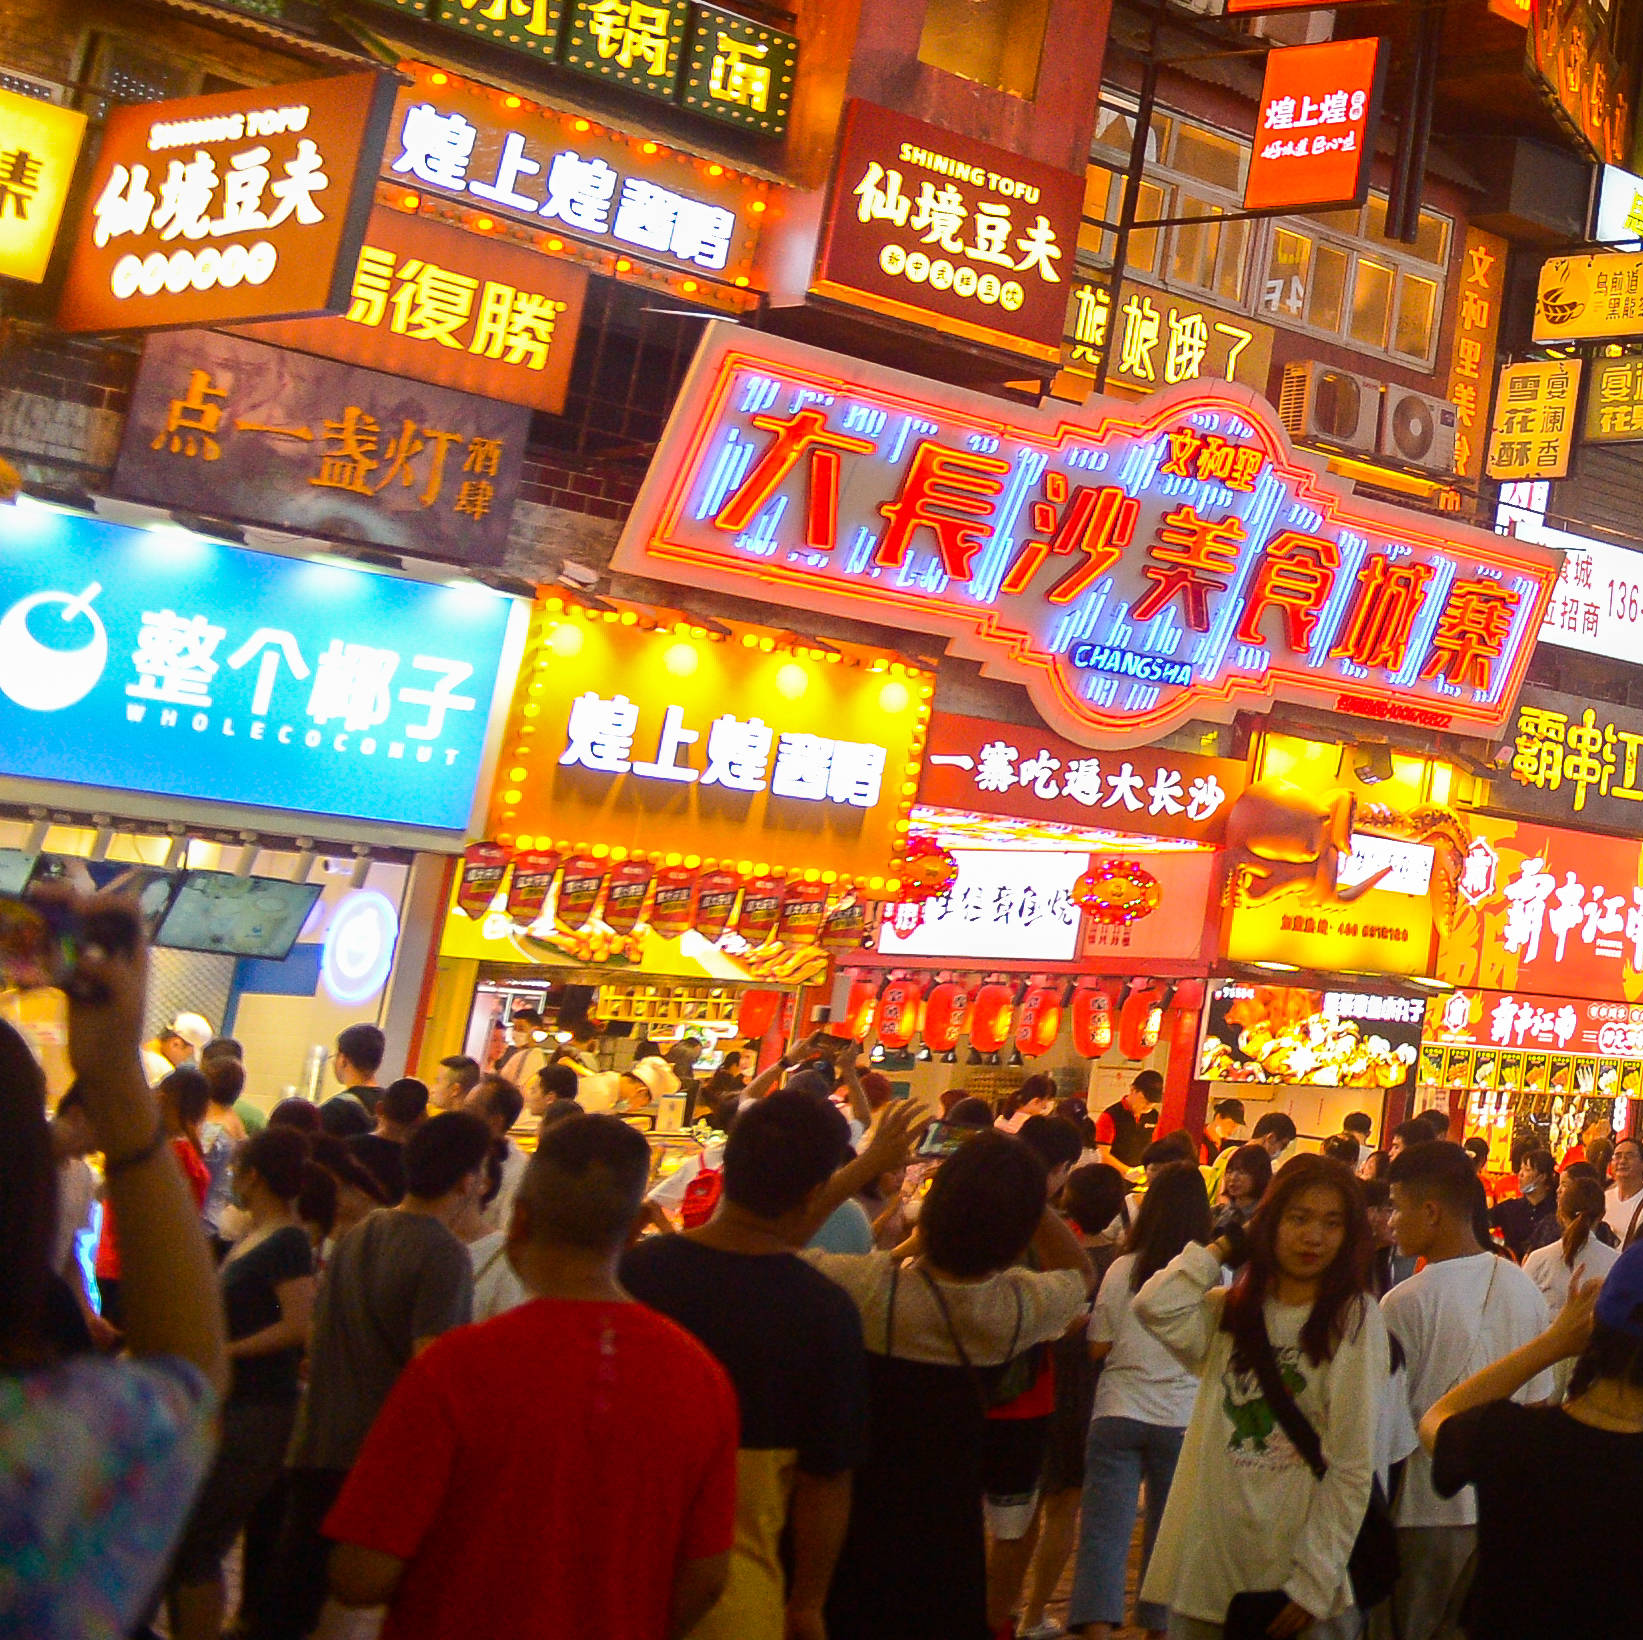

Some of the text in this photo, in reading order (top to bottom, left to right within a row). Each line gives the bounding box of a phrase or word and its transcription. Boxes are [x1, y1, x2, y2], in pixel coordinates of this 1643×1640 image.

[91, 138, 330, 248] 仙境豆夫
[852, 160, 1064, 284] 仙境豆夫
[898, 140, 1041, 207] SHINING TOFU
[149, 368, 465, 507] 点一盏灯
[125, 609, 478, 742] 整个椰子
